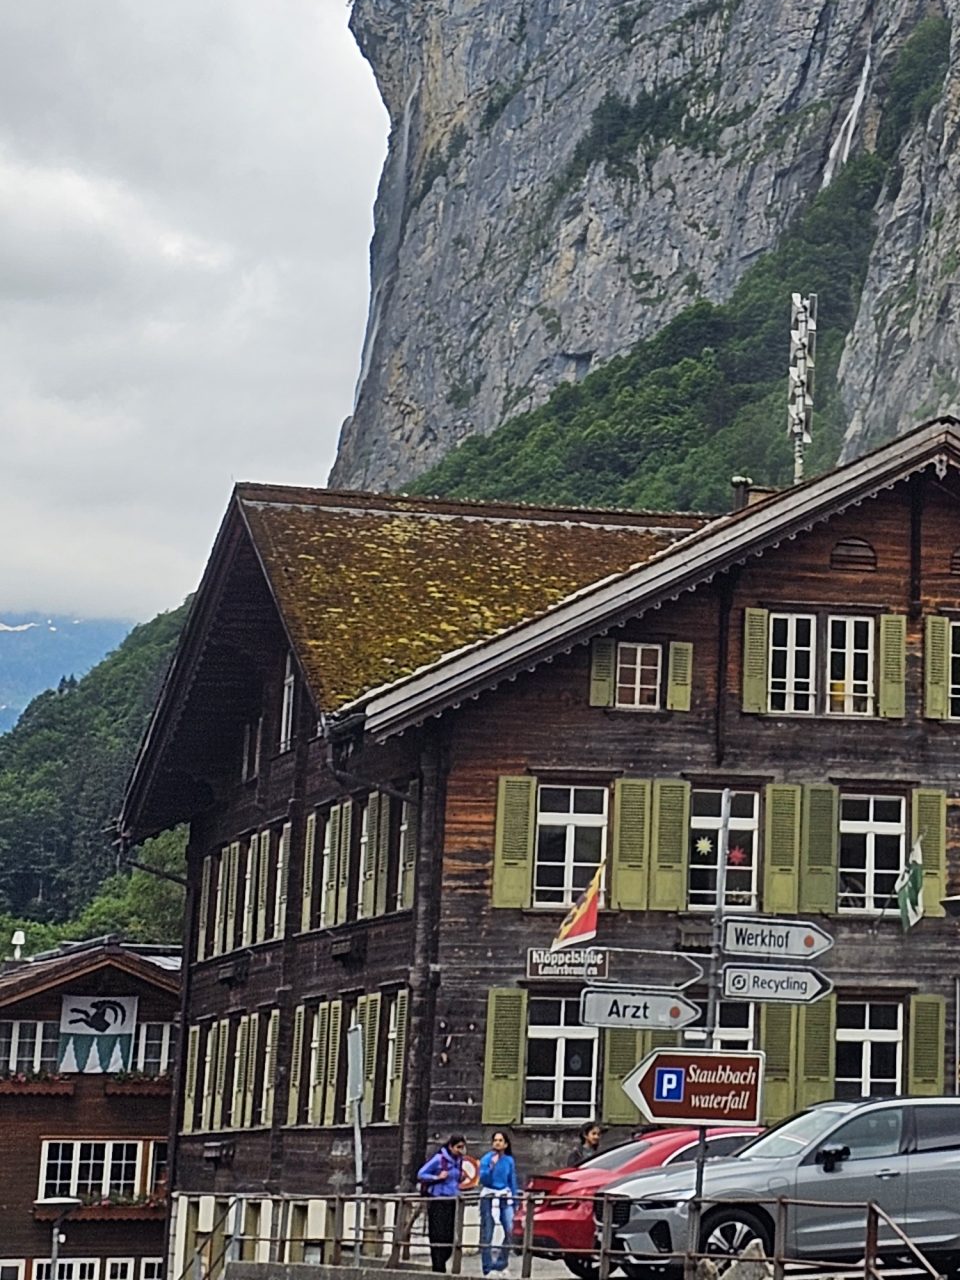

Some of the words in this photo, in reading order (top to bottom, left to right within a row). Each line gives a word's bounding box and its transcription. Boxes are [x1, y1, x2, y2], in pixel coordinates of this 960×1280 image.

[734, 927, 790, 949] Werkhof
[752, 975, 808, 995] Recycling
[607, 999, 650, 1019] Arzt
[661, 1073, 678, 1098] P
[686, 1064, 757, 1086] Staubbach
[690, 1090, 750, 1115] waterfall
